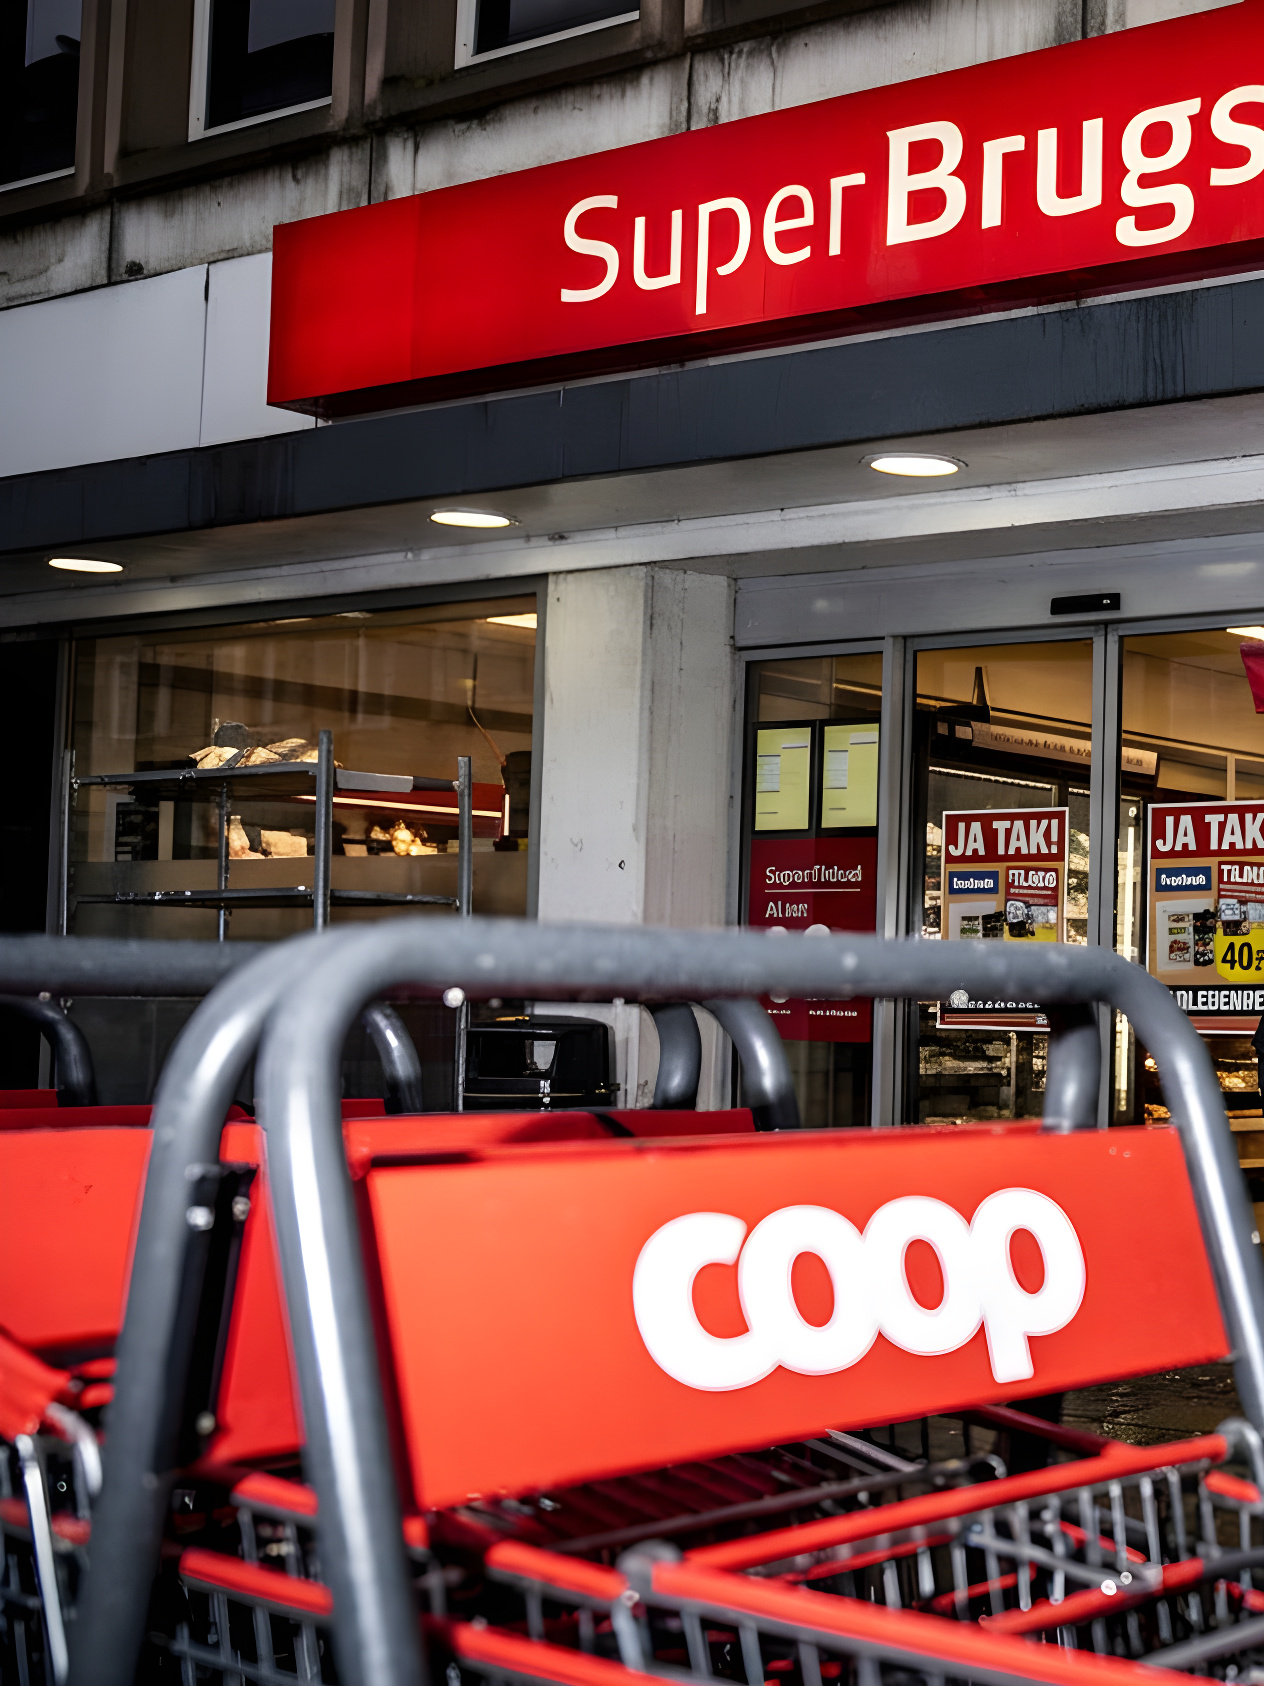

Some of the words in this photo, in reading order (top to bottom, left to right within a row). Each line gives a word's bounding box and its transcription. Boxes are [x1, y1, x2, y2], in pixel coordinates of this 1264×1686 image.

[948, 822, 985, 856] JA
[993, 819, 1058, 855] TAK!
[1156, 814, 1197, 852] JA
[632, 1187, 1087, 1391] coop
